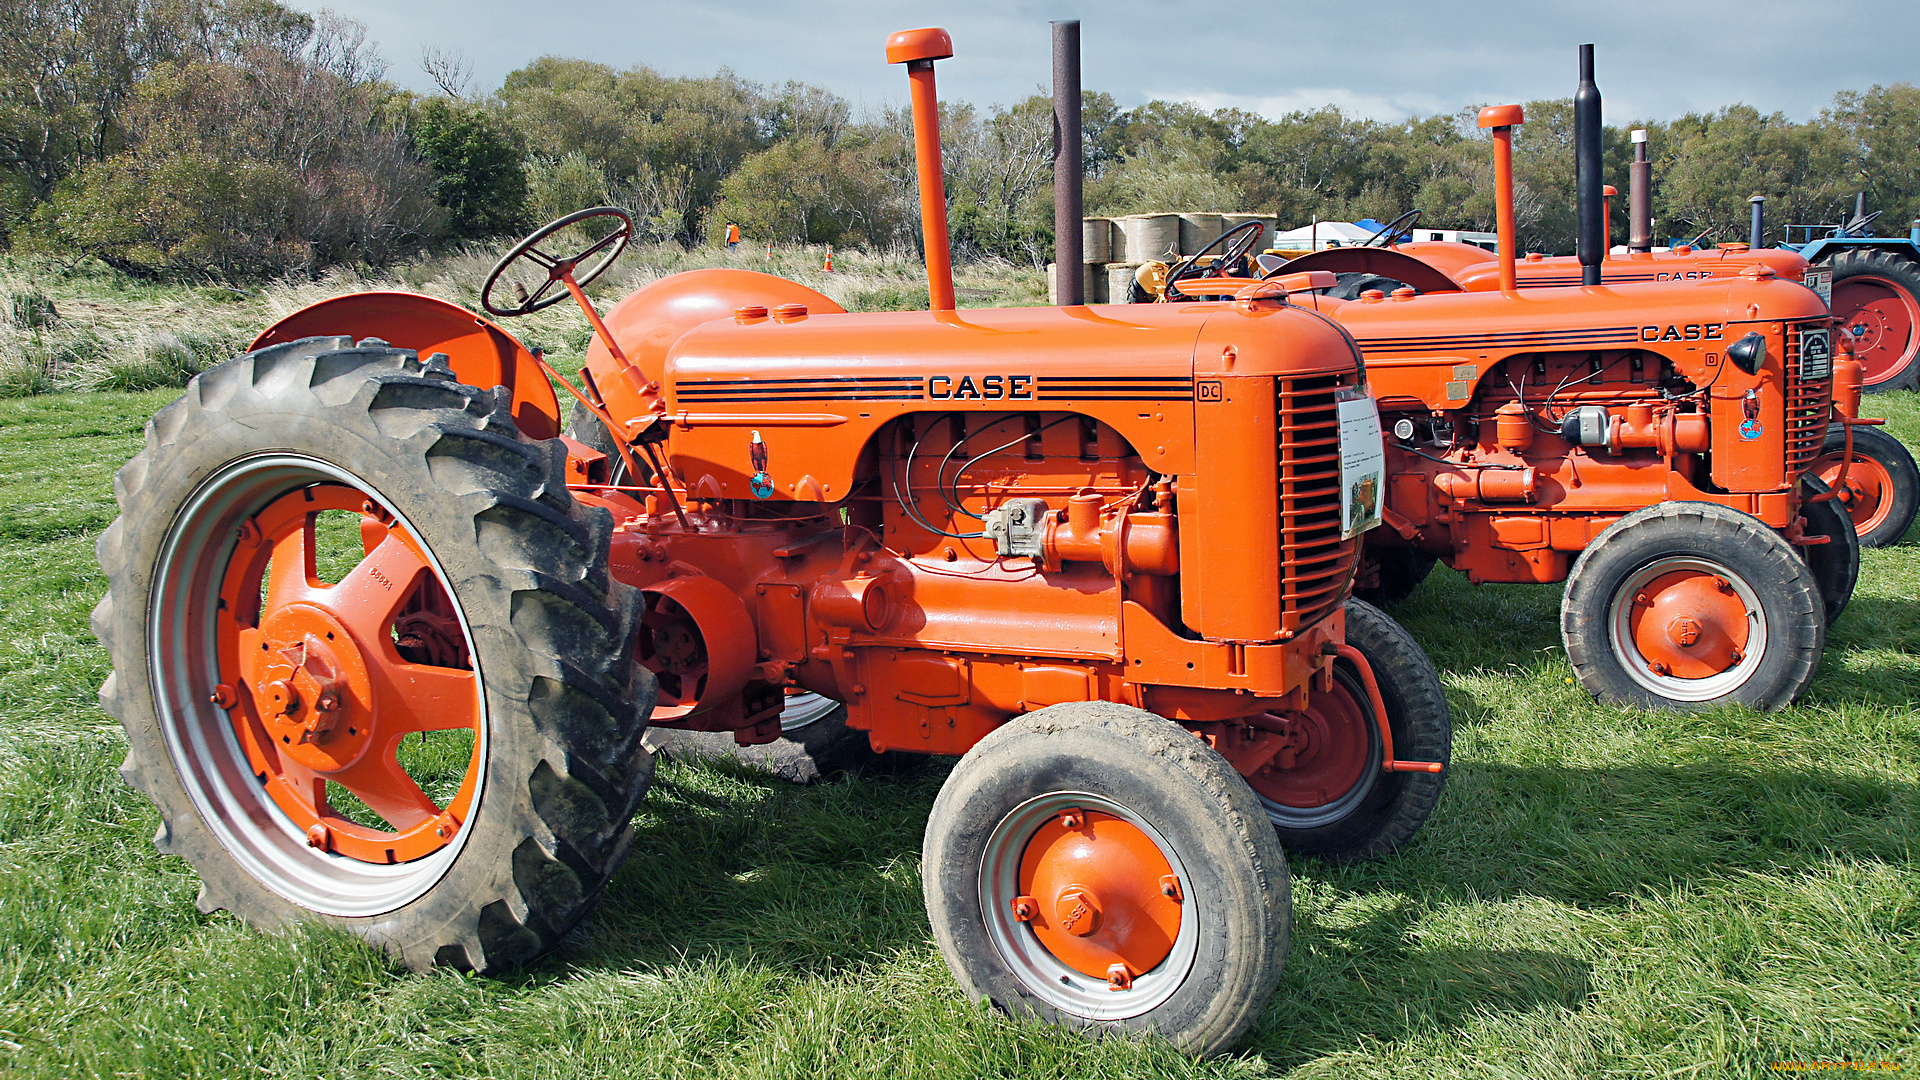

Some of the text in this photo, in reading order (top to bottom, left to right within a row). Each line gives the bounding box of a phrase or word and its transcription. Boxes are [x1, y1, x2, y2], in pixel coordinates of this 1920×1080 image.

[1642, 323, 1724, 343] CASE
[929, 375, 1033, 401] CASE
[1061, 903, 1087, 931] CASE
